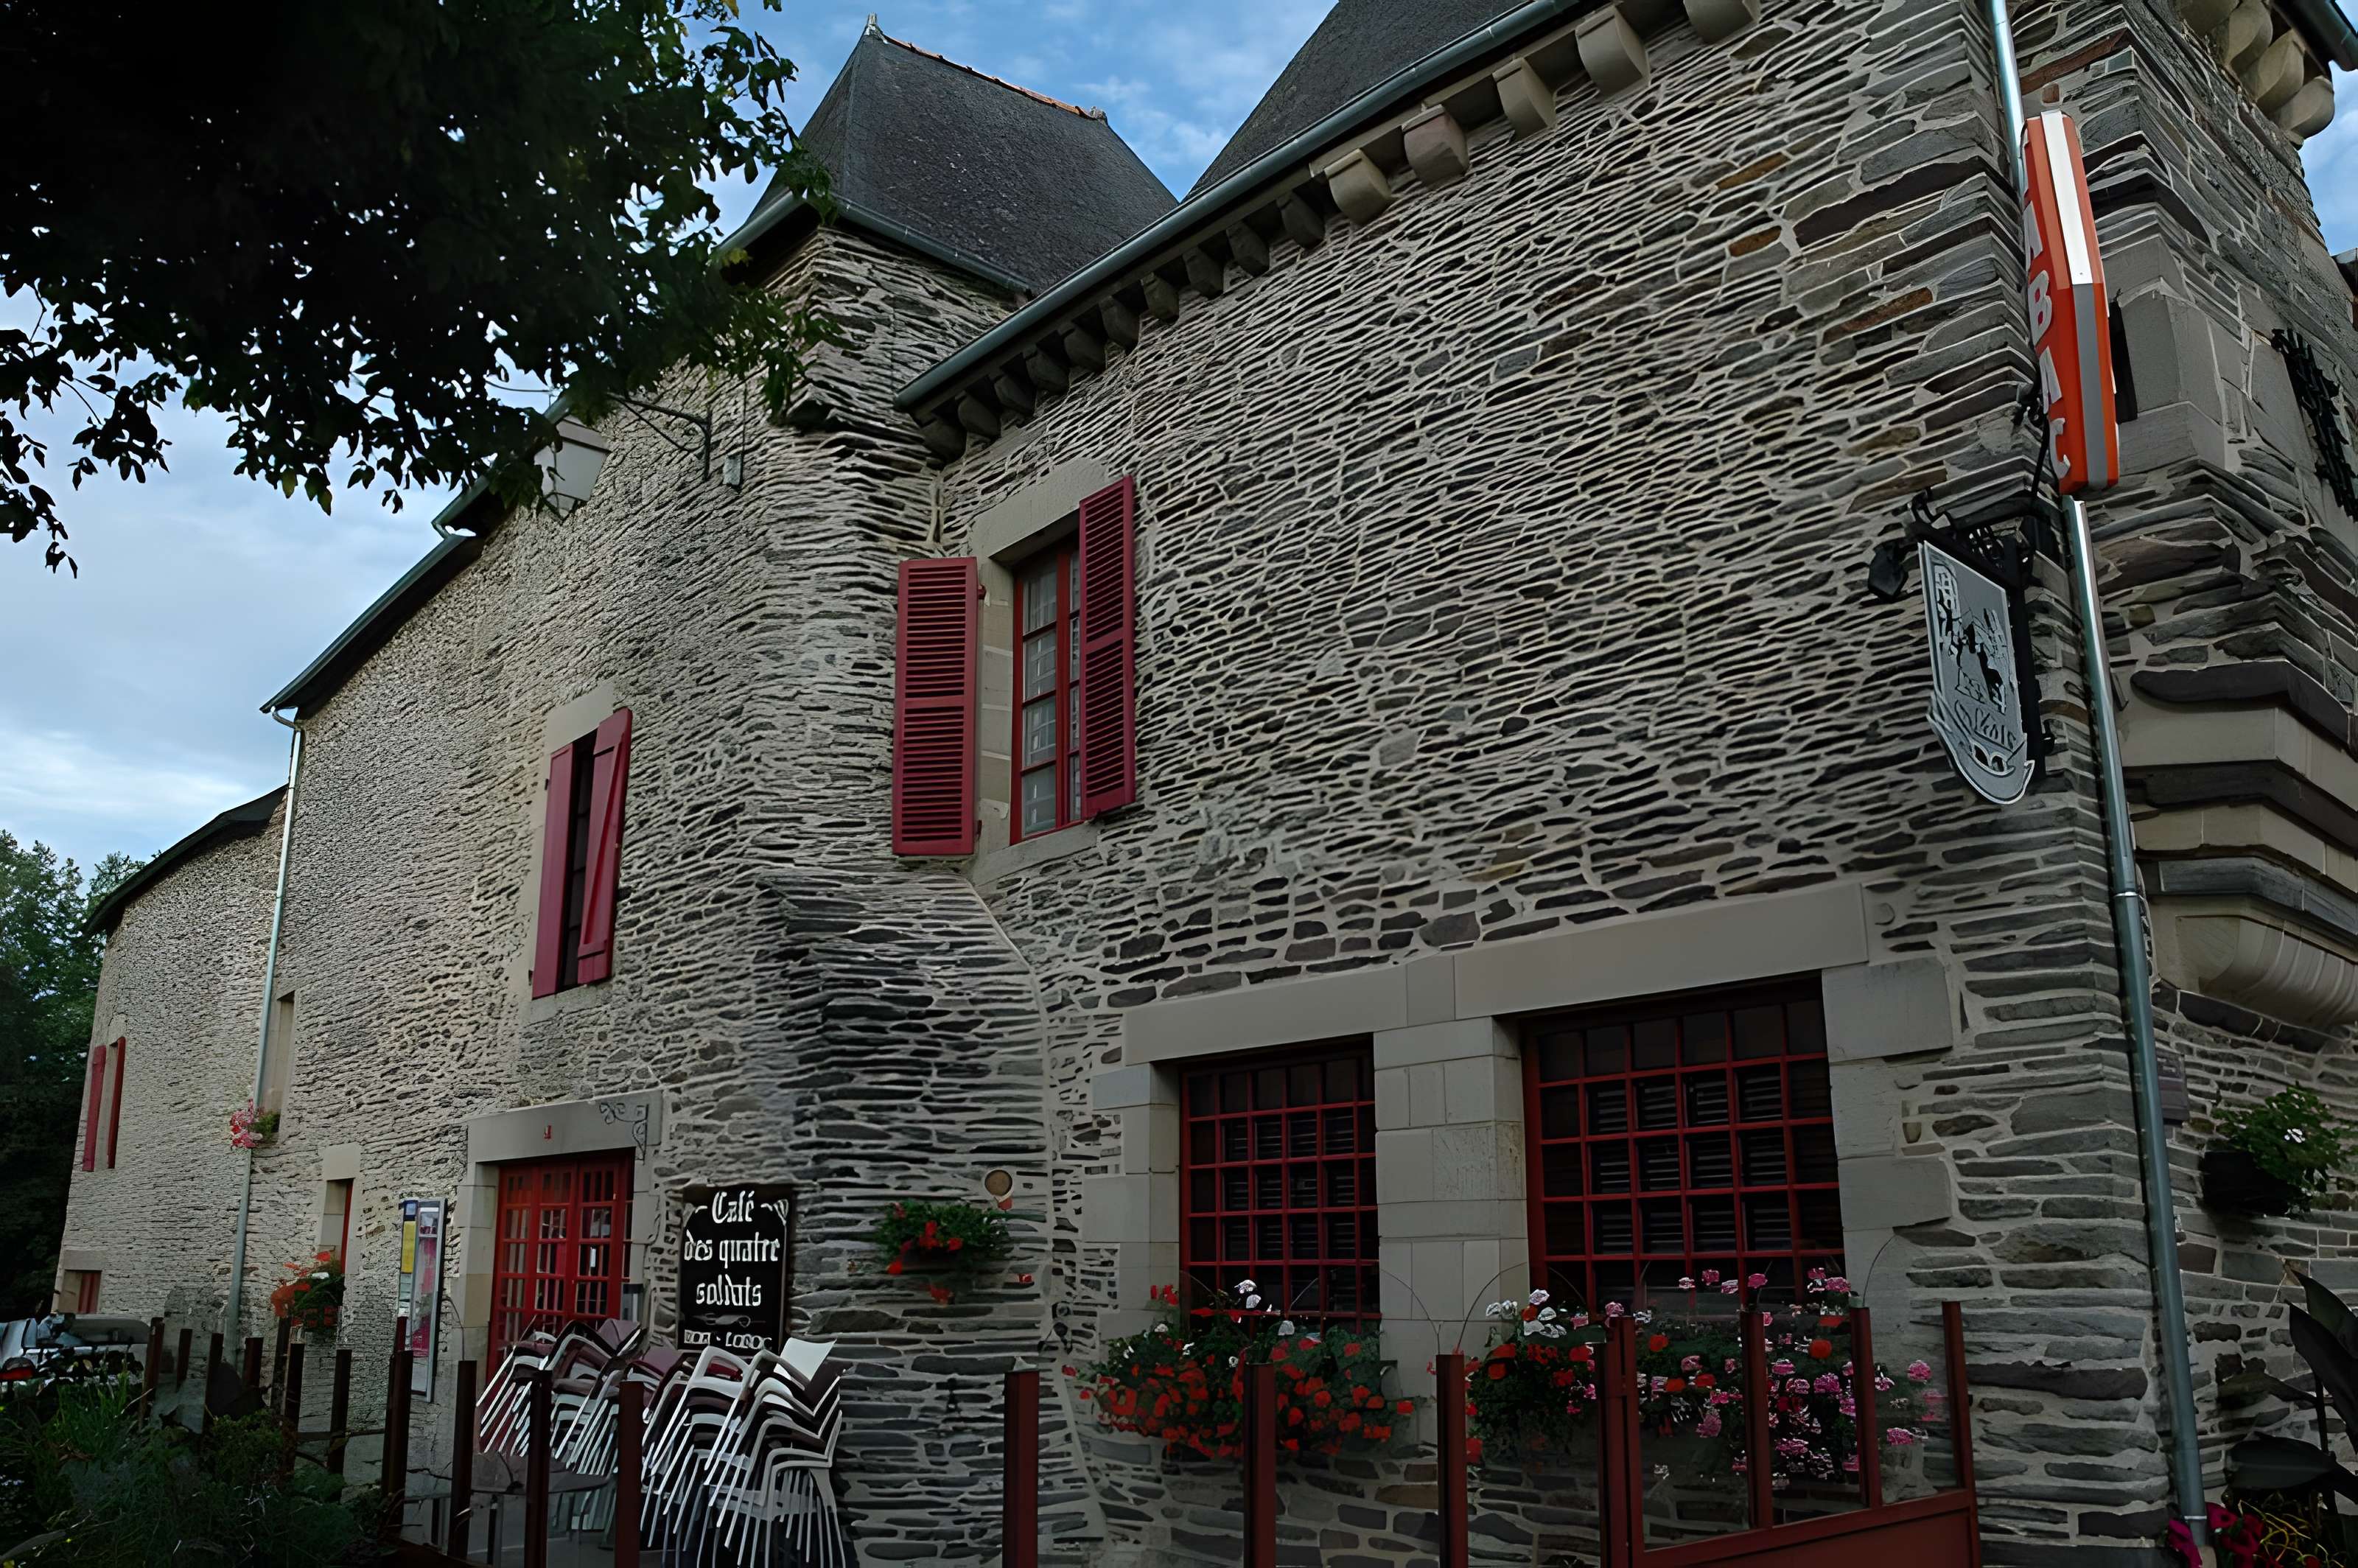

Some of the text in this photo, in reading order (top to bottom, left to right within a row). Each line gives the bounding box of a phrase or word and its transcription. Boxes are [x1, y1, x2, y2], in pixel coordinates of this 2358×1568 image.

[712, 1190, 755, 1224] Café
[684, 1229, 780, 1269] des quatre
[696, 1274, 762, 1307] soldats
